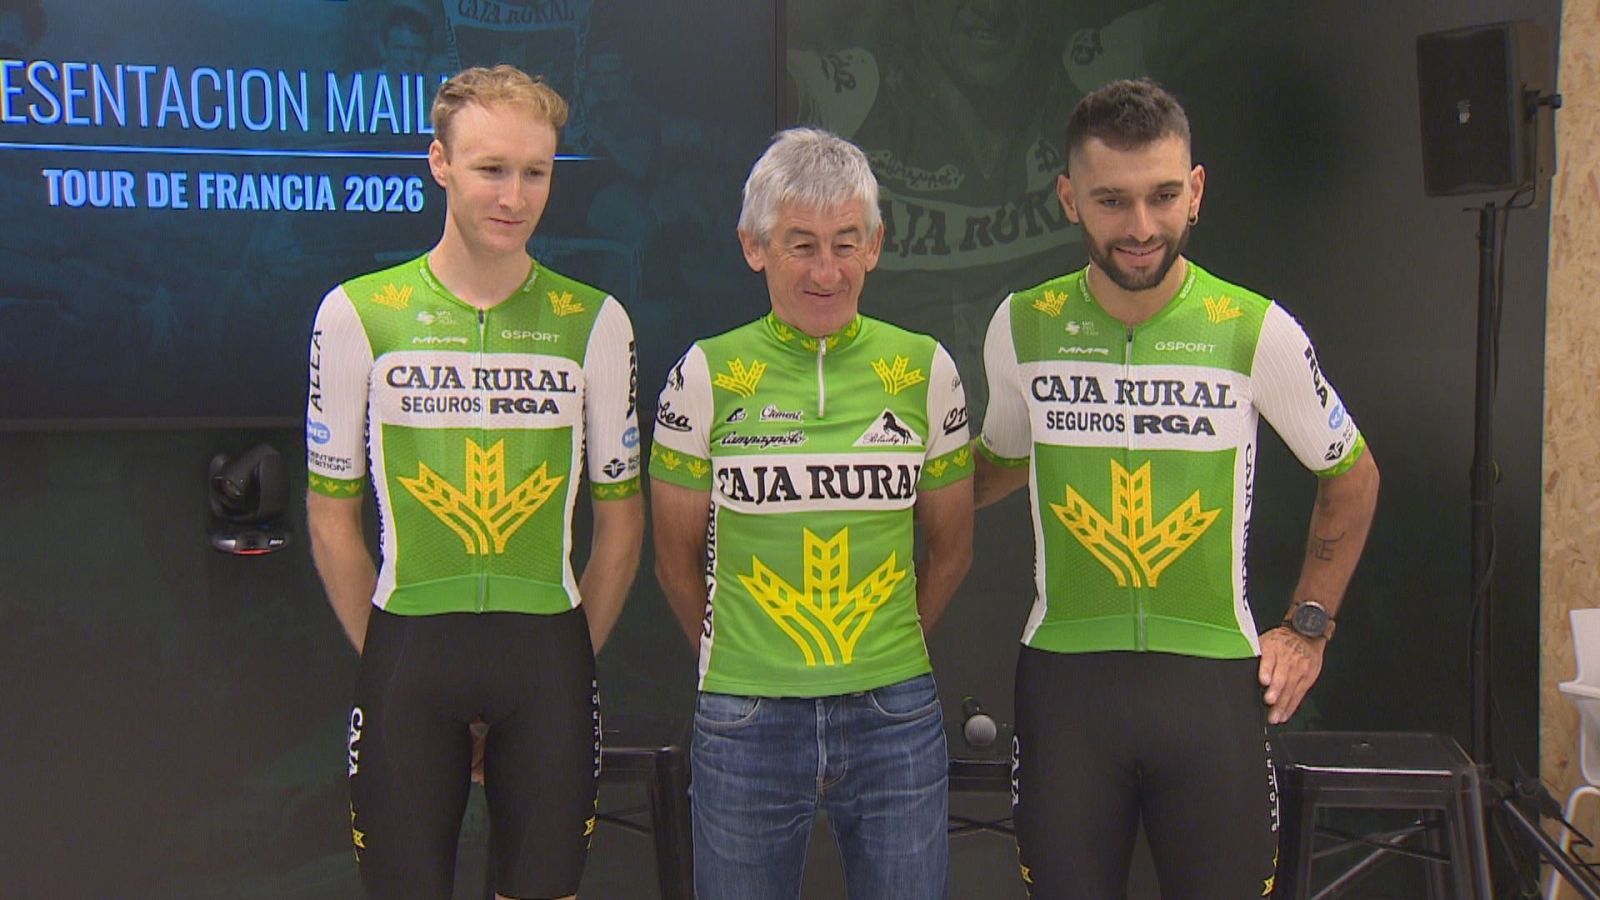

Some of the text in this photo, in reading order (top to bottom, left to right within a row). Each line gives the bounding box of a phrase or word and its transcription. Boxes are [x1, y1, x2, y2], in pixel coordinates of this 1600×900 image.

[0, 60, 447, 134] ESENTACION MAIL
[42, 169, 424, 212] TOUR DE FRANCIA 2026
[878, 199, 950, 258] AJA
[501, 329, 560, 343] GSPORT
[1155, 341, 1216, 353] GSPORT
[386, 366, 577, 393] CAJA RURAL
[1031, 375, 1237, 408] CAJA RURAL
[401, 396, 560, 414] SEGUROS RGA
[1046, 411, 1216, 436] SEGUROS RGA
[1263, 726, 1278, 832] SEGURO
